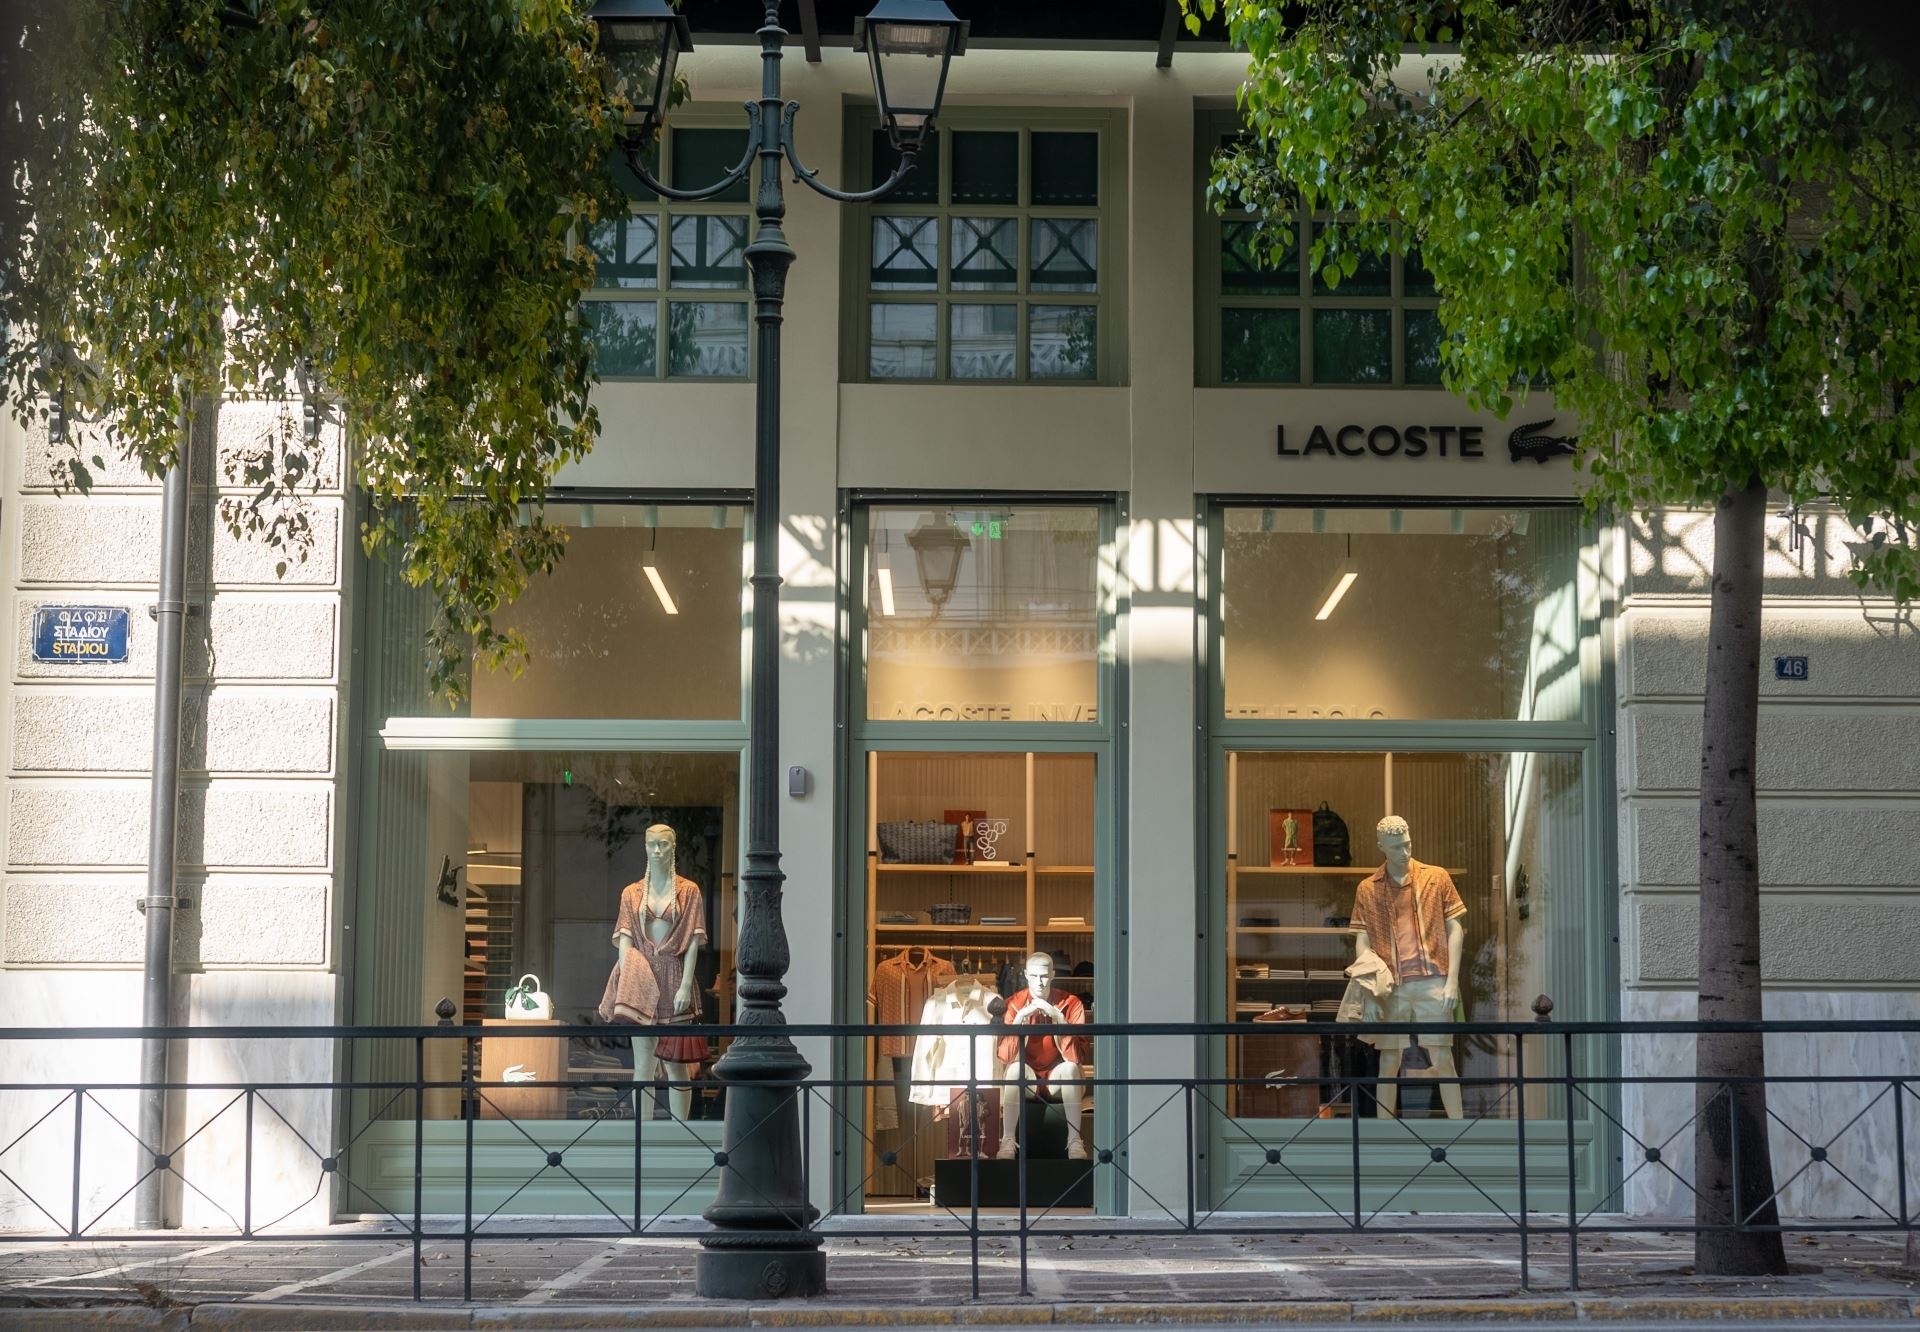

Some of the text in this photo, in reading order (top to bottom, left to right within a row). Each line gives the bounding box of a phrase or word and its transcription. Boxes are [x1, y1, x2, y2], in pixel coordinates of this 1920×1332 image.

[1277, 424, 1484, 457] LACOSTE
[53, 625, 110, 638] ΣΤΑΔΙΟΥ
[52, 642, 109, 655] STADIOU
[1783, 660, 1803, 676] 46
